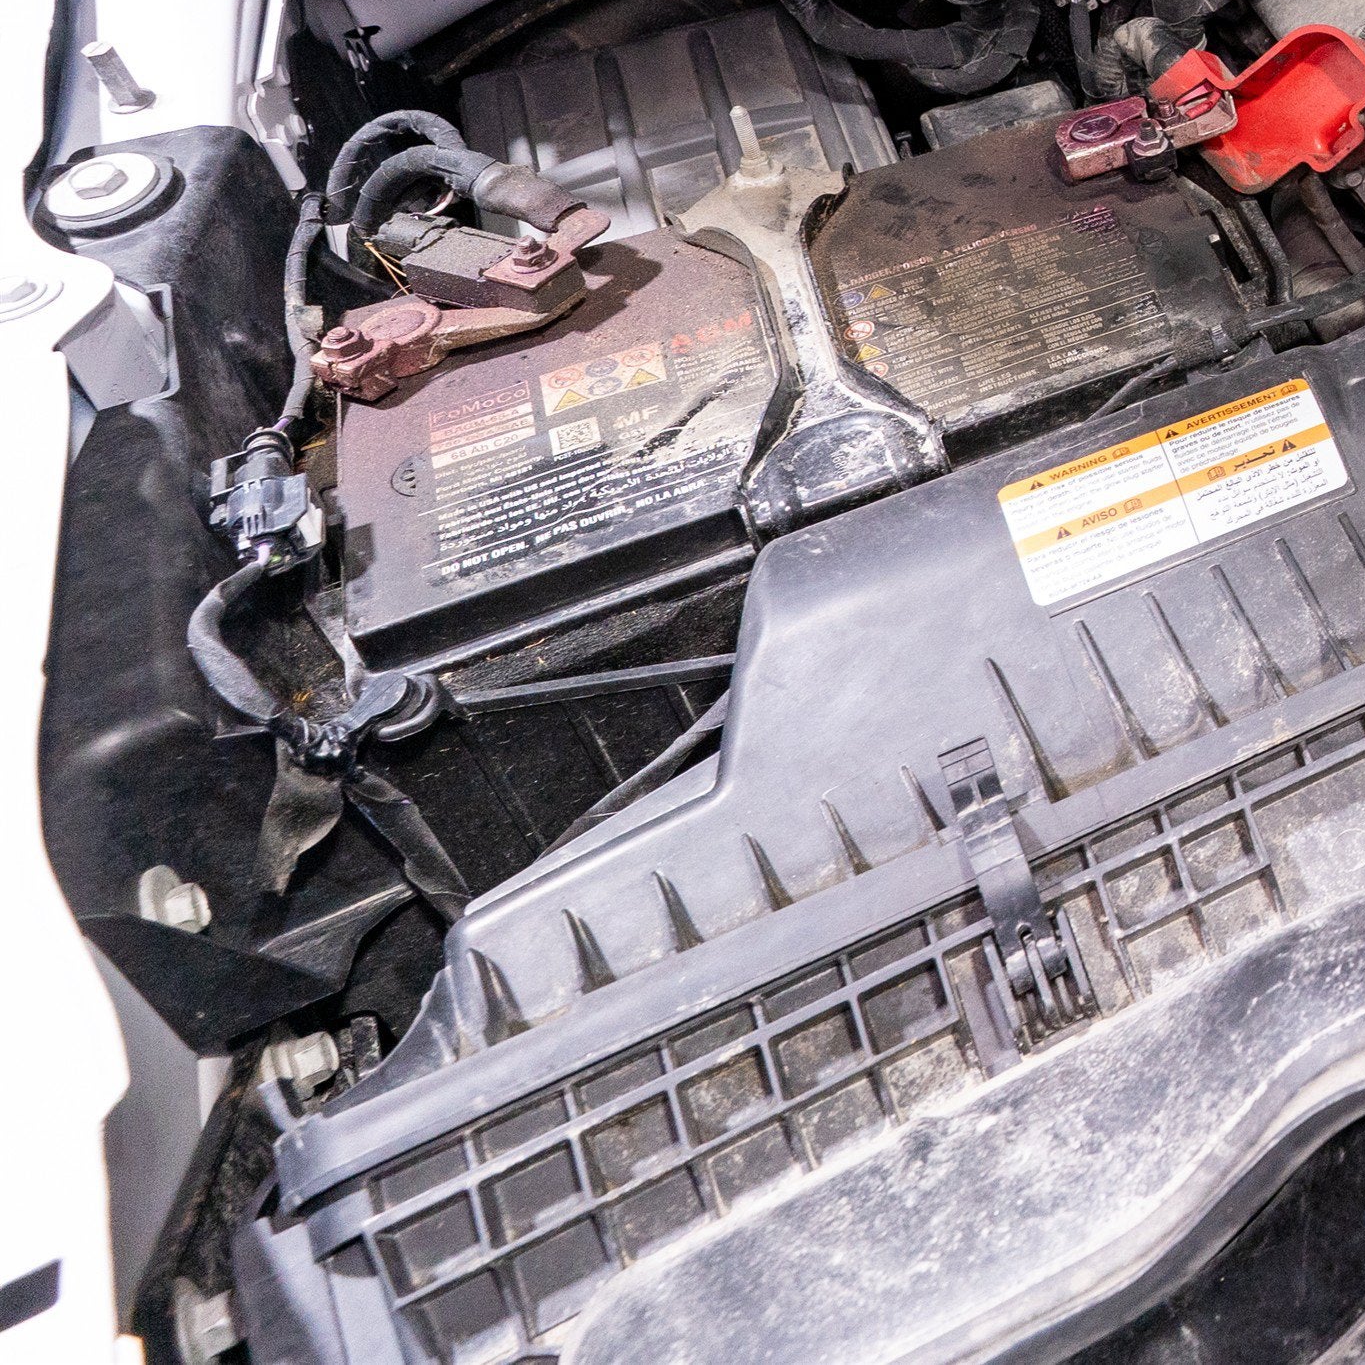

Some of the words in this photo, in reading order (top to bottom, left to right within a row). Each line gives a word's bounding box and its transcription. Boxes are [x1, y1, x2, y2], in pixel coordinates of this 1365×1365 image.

[1168, 436, 1187, 446] Pour
[1226, 412, 1251, 426] risque
[1252, 407, 1262, 415] de
[1262, 393, 1300, 411] blessures
[1171, 439, 1199, 454] graves
[1199, 434, 1210, 442] ou
[1211, 429, 1221, 438] de
[1289, 400, 1300, 408] de
[1185, 391, 1277, 429] AVERTISSEMENT
[1199, 441, 1209, 449] de
[1048, 454, 1107, 481] WARNING
[439, 562, 460, 576] DO
[461, 552, 490, 569] NOT
[490, 538, 530, 559] OPEN.
[533, 530, 552, 543] NE
[551, 520, 578, 536] PAS
[635, 496, 653, 508] NO
[654, 489, 671, 502] LA
[1079, 506, 1118, 528] AVISO
